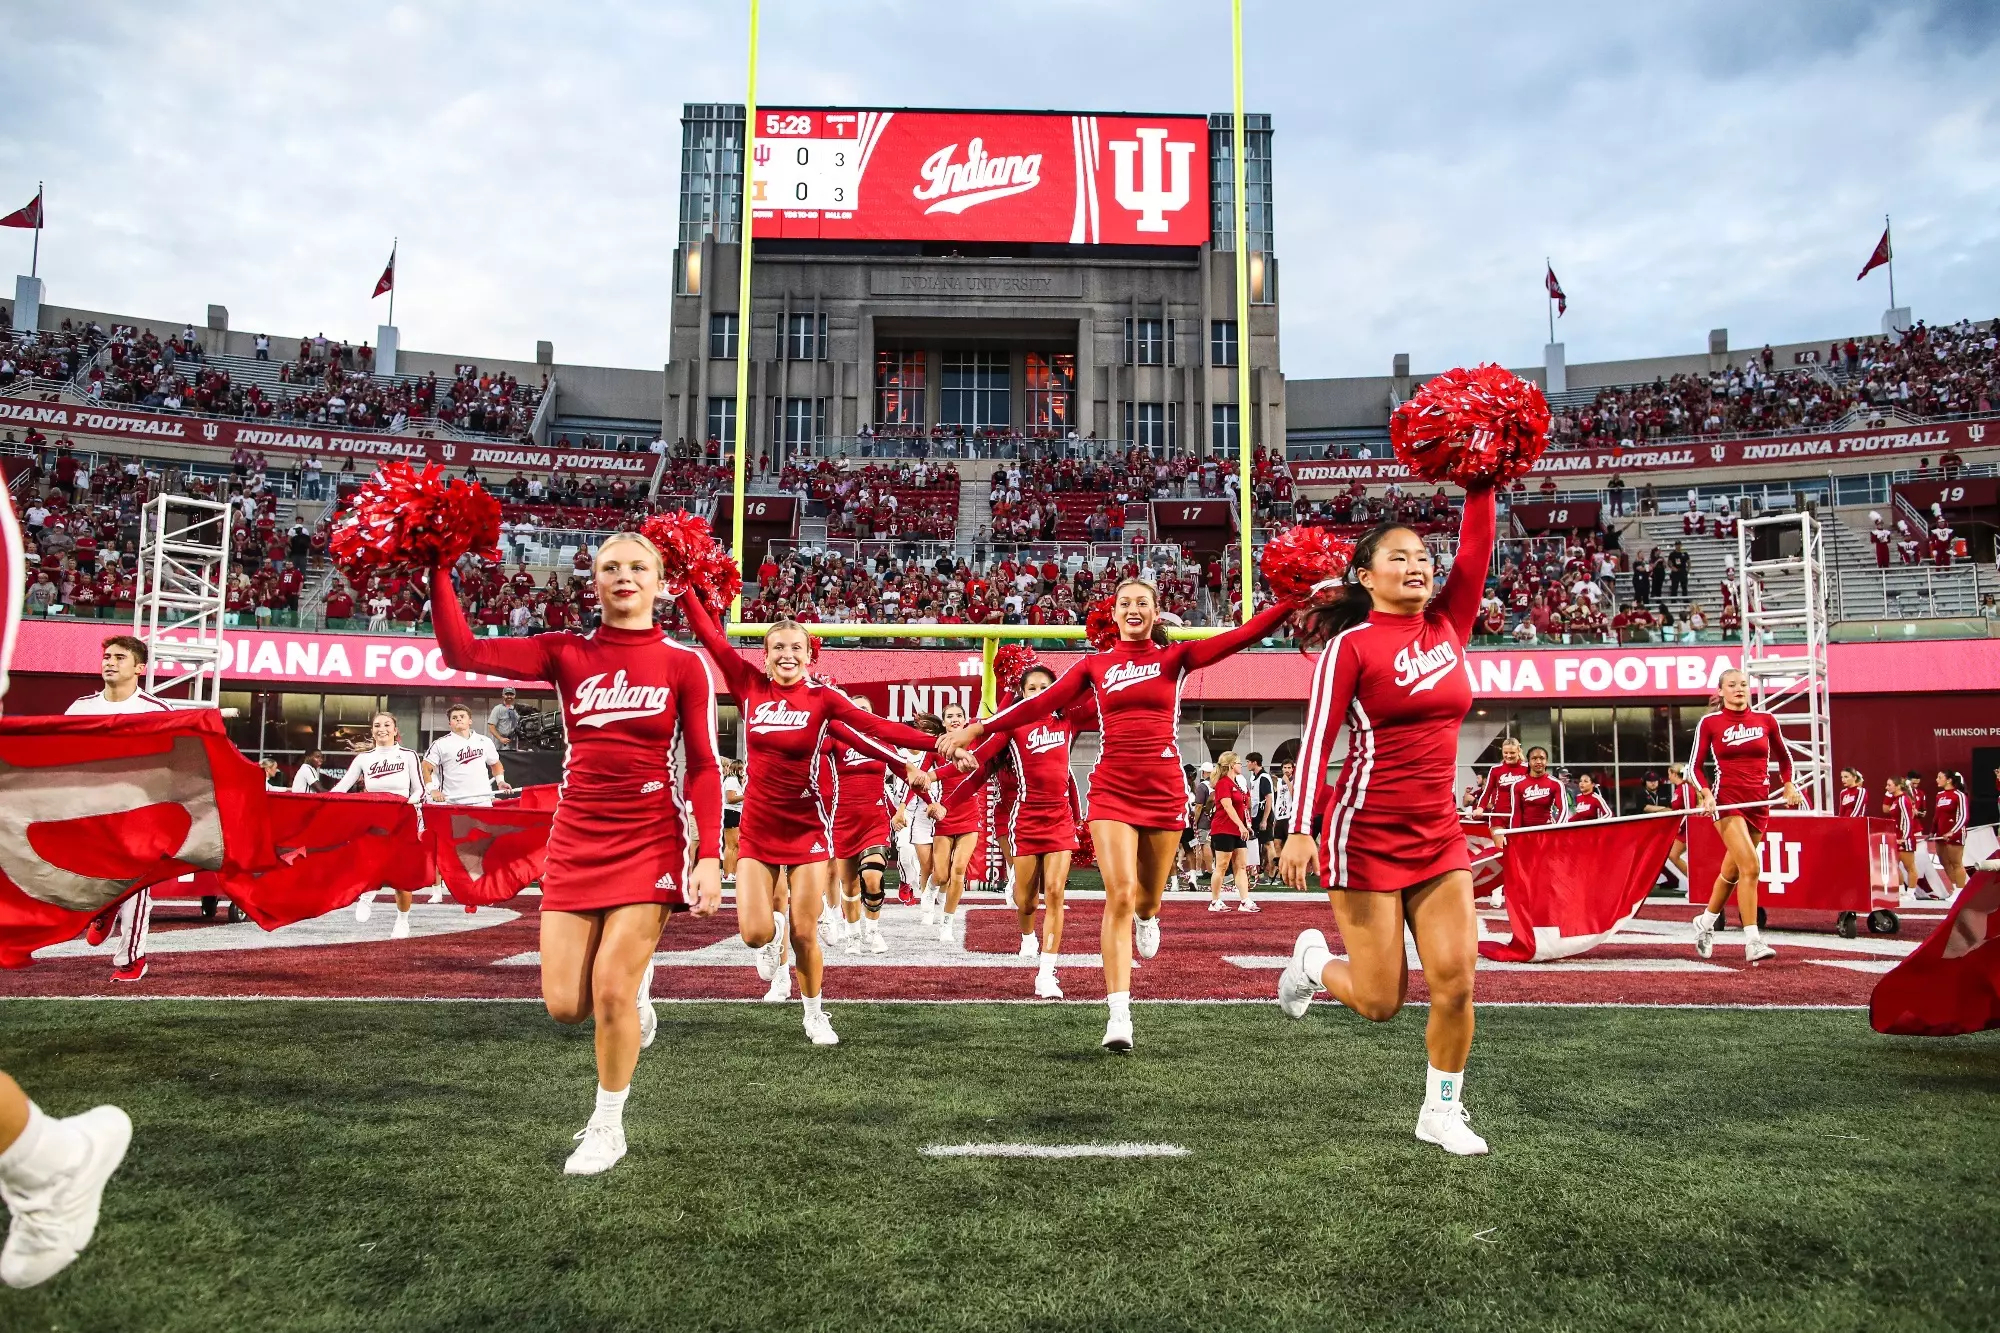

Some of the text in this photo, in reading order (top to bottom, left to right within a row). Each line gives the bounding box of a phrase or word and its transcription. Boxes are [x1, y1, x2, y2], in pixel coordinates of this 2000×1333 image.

[766, 114, 812, 135] 5:28
[835, 122, 844, 136] 1
[796, 147, 809, 165] 0
[835, 152, 845, 167] 3
[912, 137, 1043, 201] Indiana
[795, 182, 808, 201] 0
[833, 187, 844, 202] 3
[901, 276, 1052, 292] INDIANA UNIVERSITY
[72, 412, 185, 437] FOOTBALL
[235, 429, 427, 458] INDIANA FOOTBALL
[1742, 430, 1950, 460] INDIANA FOOTBALL
[471, 448, 646, 472] INDIANA FOOTBALL
[1532, 449, 1695, 472] DIANA FOOTBALL
[1297, 465, 1372, 480] INDIANA
[1940, 487, 1964, 503] 19
[747, 502, 766, 516] 16
[1182, 507, 1202, 520] 17
[1548, 509, 1568, 524] 18
[152, 636, 352, 677] DIANA
[1394, 640, 1458, 687] Indiana
[1102, 660, 1161, 689] Indiana
[1554, 653, 1796, 692] FOOTBA
[570, 669, 670, 715] Indiana
[750, 699, 811, 726] Indiana
[886, 685, 981, 724] INDI
[1025, 724, 1066, 750] Indiana
[1721, 723, 1764, 743] Indiana
[1933, 728, 1988, 736] WILKINSON
[455, 746, 484, 763] Indiana
[367, 759, 405, 776] Indiana
[1523, 784, 1551, 799] Indiana
